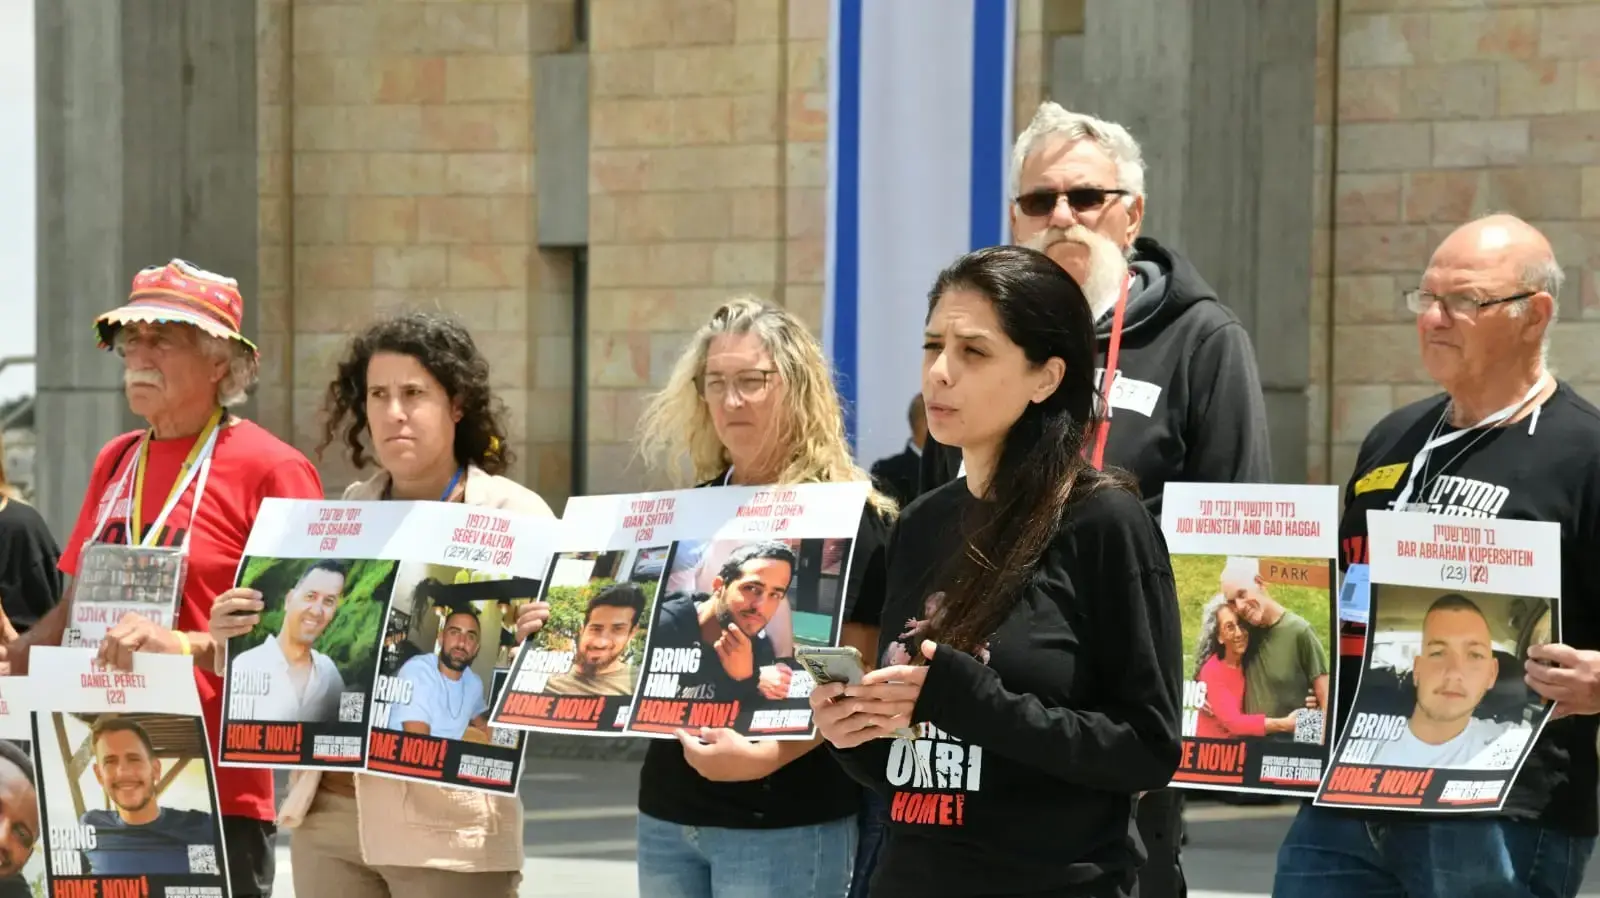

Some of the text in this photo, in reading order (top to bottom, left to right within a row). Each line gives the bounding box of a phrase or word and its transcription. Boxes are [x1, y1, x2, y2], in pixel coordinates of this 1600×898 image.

[656, 498, 676, 513] עידן
[1428, 475, 1510, 514] מחזירים
[622, 512, 674, 528] IDAN SHTIVI
[736, 504, 805, 517] NIMROD COHEN
[307, 523, 362, 536] YOSI SHARABI
[452, 527, 516, 549] SEGEV KALFON
[1176, 518, 1320, 537] JUDI WEINSTEIN AND GAD HAGGAI
[1433, 524, 1495, 545] בר קופרשטיין
[320, 537, 338, 552] (53)
[1397, 541, 1533, 567] BAR ABRAHAM KUPERSHTEIN
[1270, 565, 1309, 581] PARK
[1440, 565, 1467, 584] (23)
[520, 649, 574, 674] BRING
[651, 647, 702, 673] BRING
[80, 674, 146, 689] DANIEL PERETZ
[232, 670, 272, 696] BRING
[371, 674, 414, 706] RING
[644, 674, 680, 699] HIM
[106, 689, 126, 705] (22)
[502, 692, 555, 718] HOME
[553, 696, 607, 721] NOW!
[370, 701, 391, 729] IM
[637, 700, 689, 725] HOME
[688, 700, 741, 728] NOW!
[226, 723, 303, 752] HOME NOW!
[1350, 712, 1407, 742] BRING
[369, 731, 400, 761] OME
[400, 737, 448, 769] NOW!
[1197, 742, 1246, 773] NOW!
[1339, 738, 1379, 764] HIM
[1261, 765, 1321, 782] FAMILIES FORUM
[1327, 766, 1382, 793] HOME
[1378, 768, 1435, 796] NOW!
[890, 791, 965, 826] HOME!
[51, 825, 97, 850] BRING
[51, 850, 82, 876] HIM
[53, 879, 99, 898] HOME
[102, 876, 149, 898] NOW!
